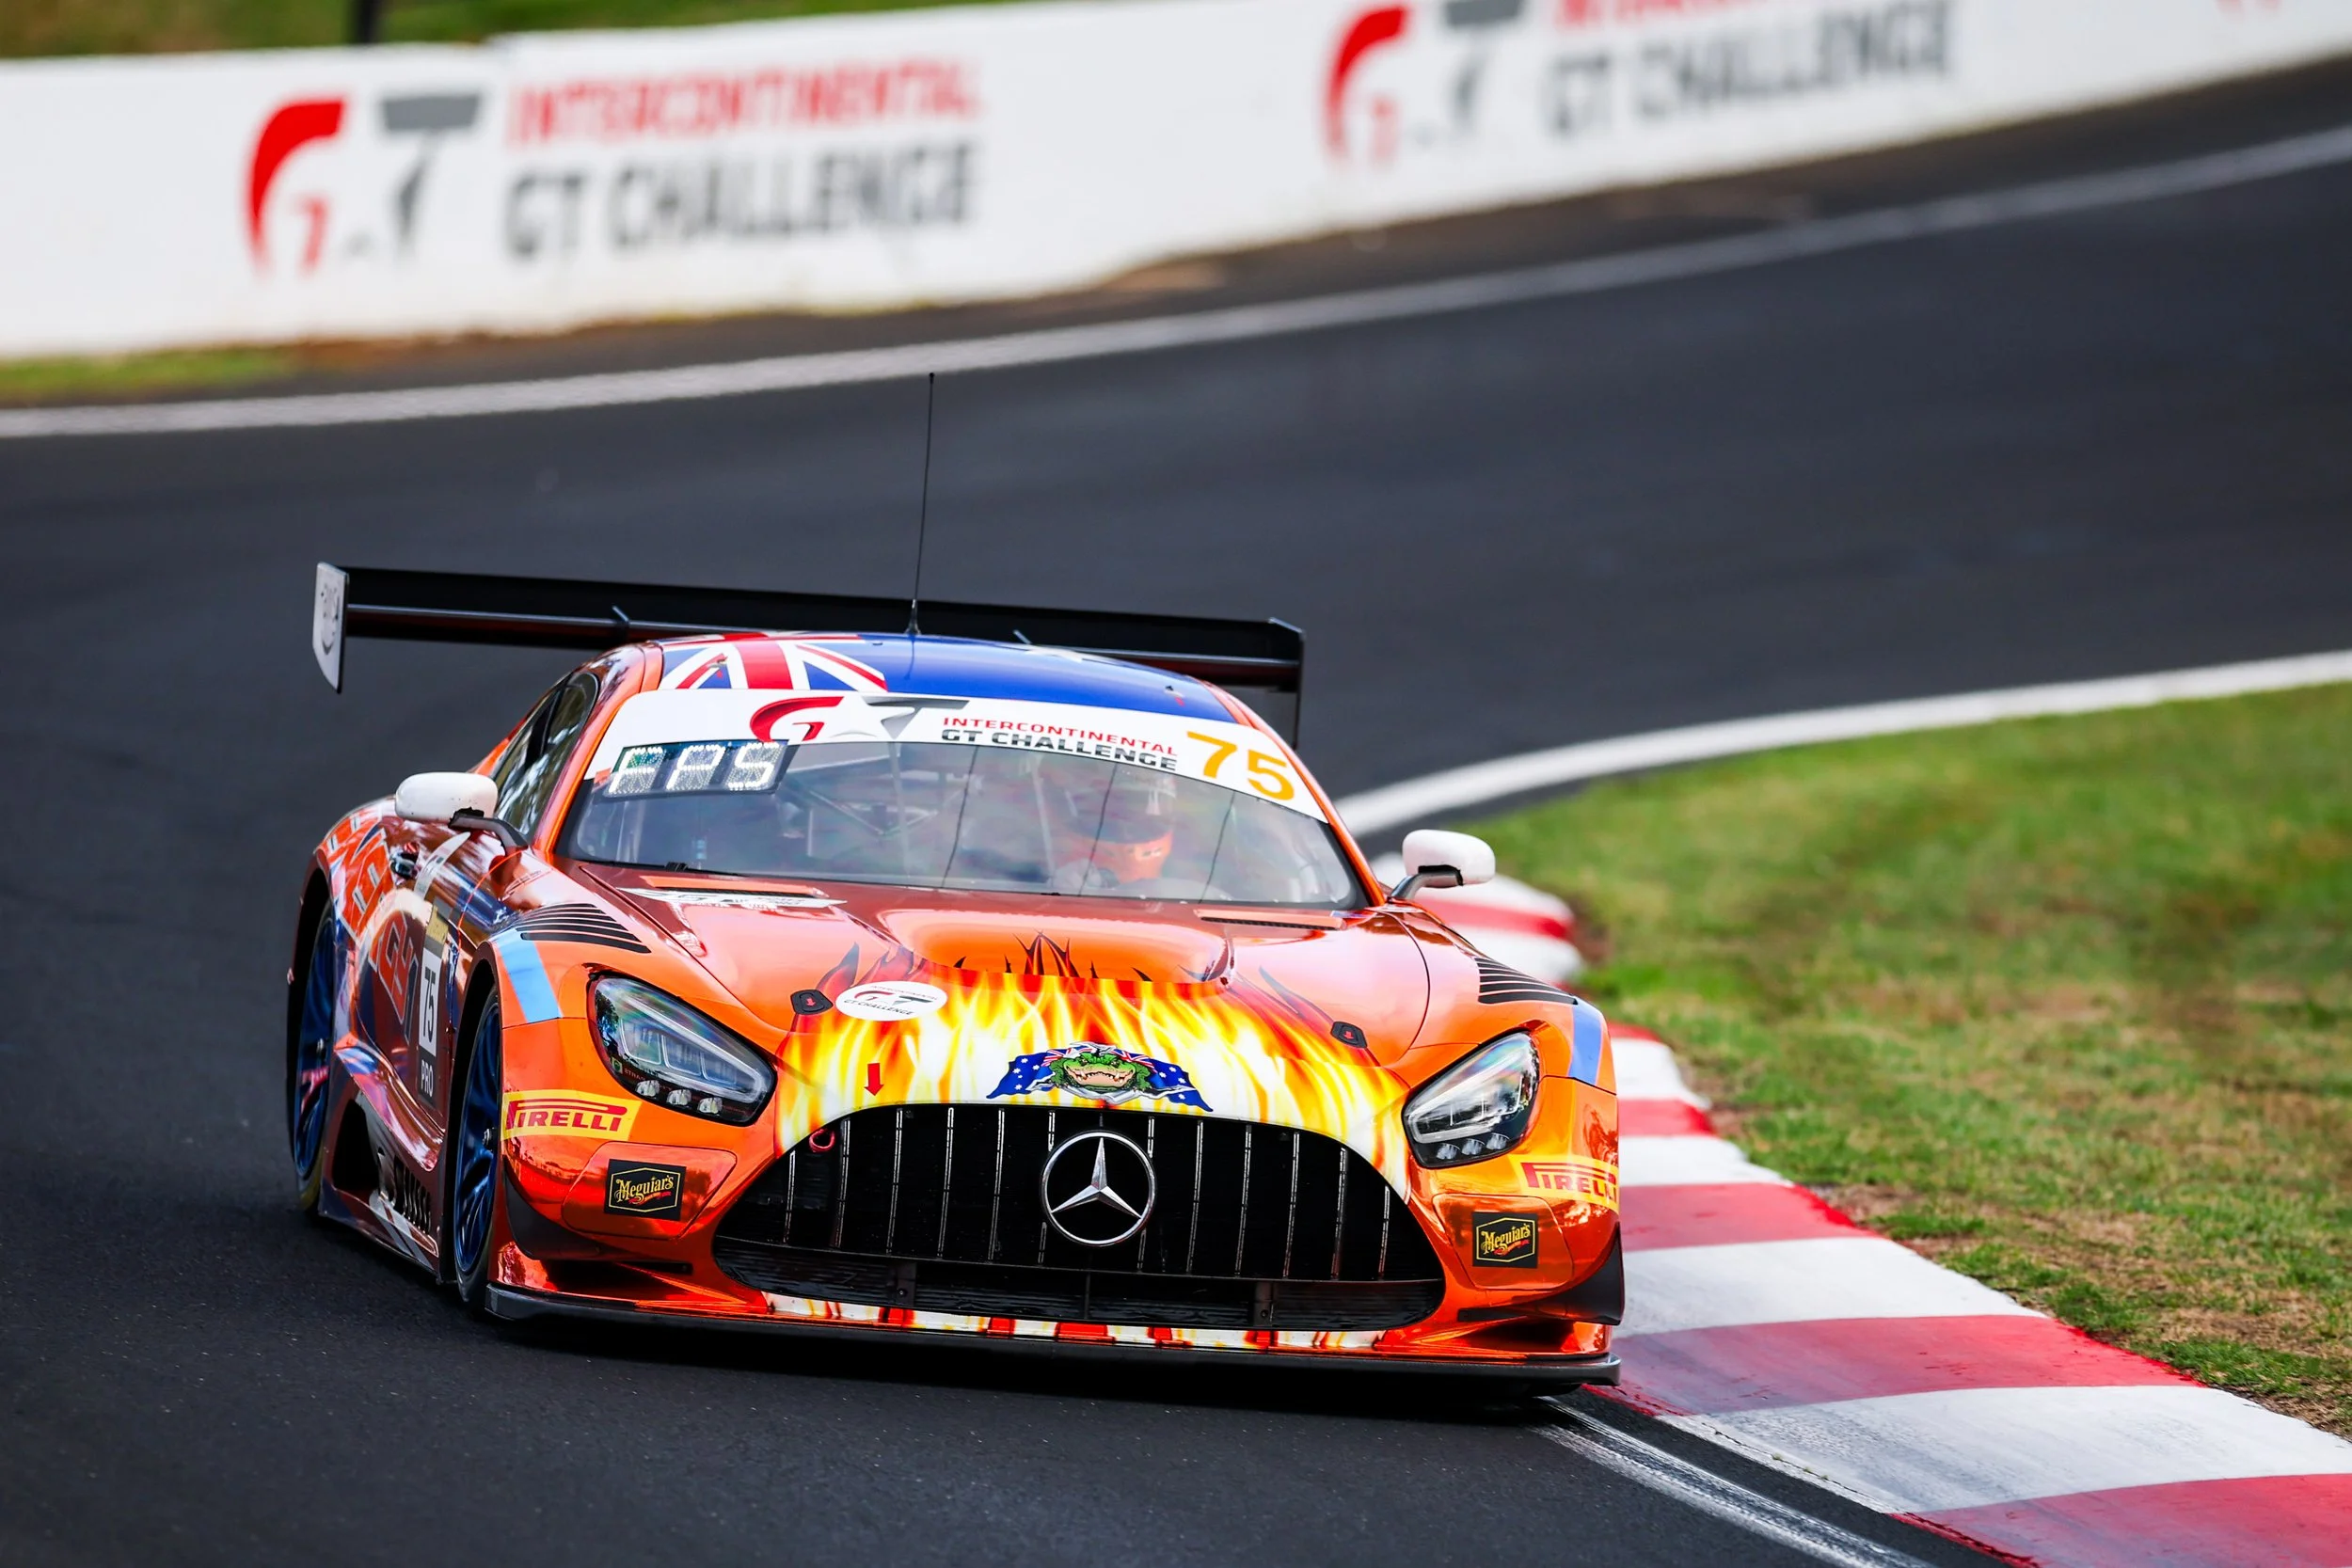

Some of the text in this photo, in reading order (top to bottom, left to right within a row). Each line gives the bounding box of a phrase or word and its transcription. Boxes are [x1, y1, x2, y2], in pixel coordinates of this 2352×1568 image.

[506, 141, 977, 261] GT CHALLENGE
[941, 729, 1178, 771] GT CHALLENGE
[943, 718, 1178, 755] INTERCONTINENTAL
[1186, 731, 1295, 800] 75
[422, 966, 437, 1043] 75
[857, 1001, 914, 1016] CHALLENGE
[420, 1059, 435, 1098] PRO
[505, 1098, 628, 1132] PIRELLI
[614, 1175, 674, 1205] Meguiar's
[1520, 1162, 1617, 1203] PIRELLI
[1481, 1223, 1531, 1256] Meguiar's
